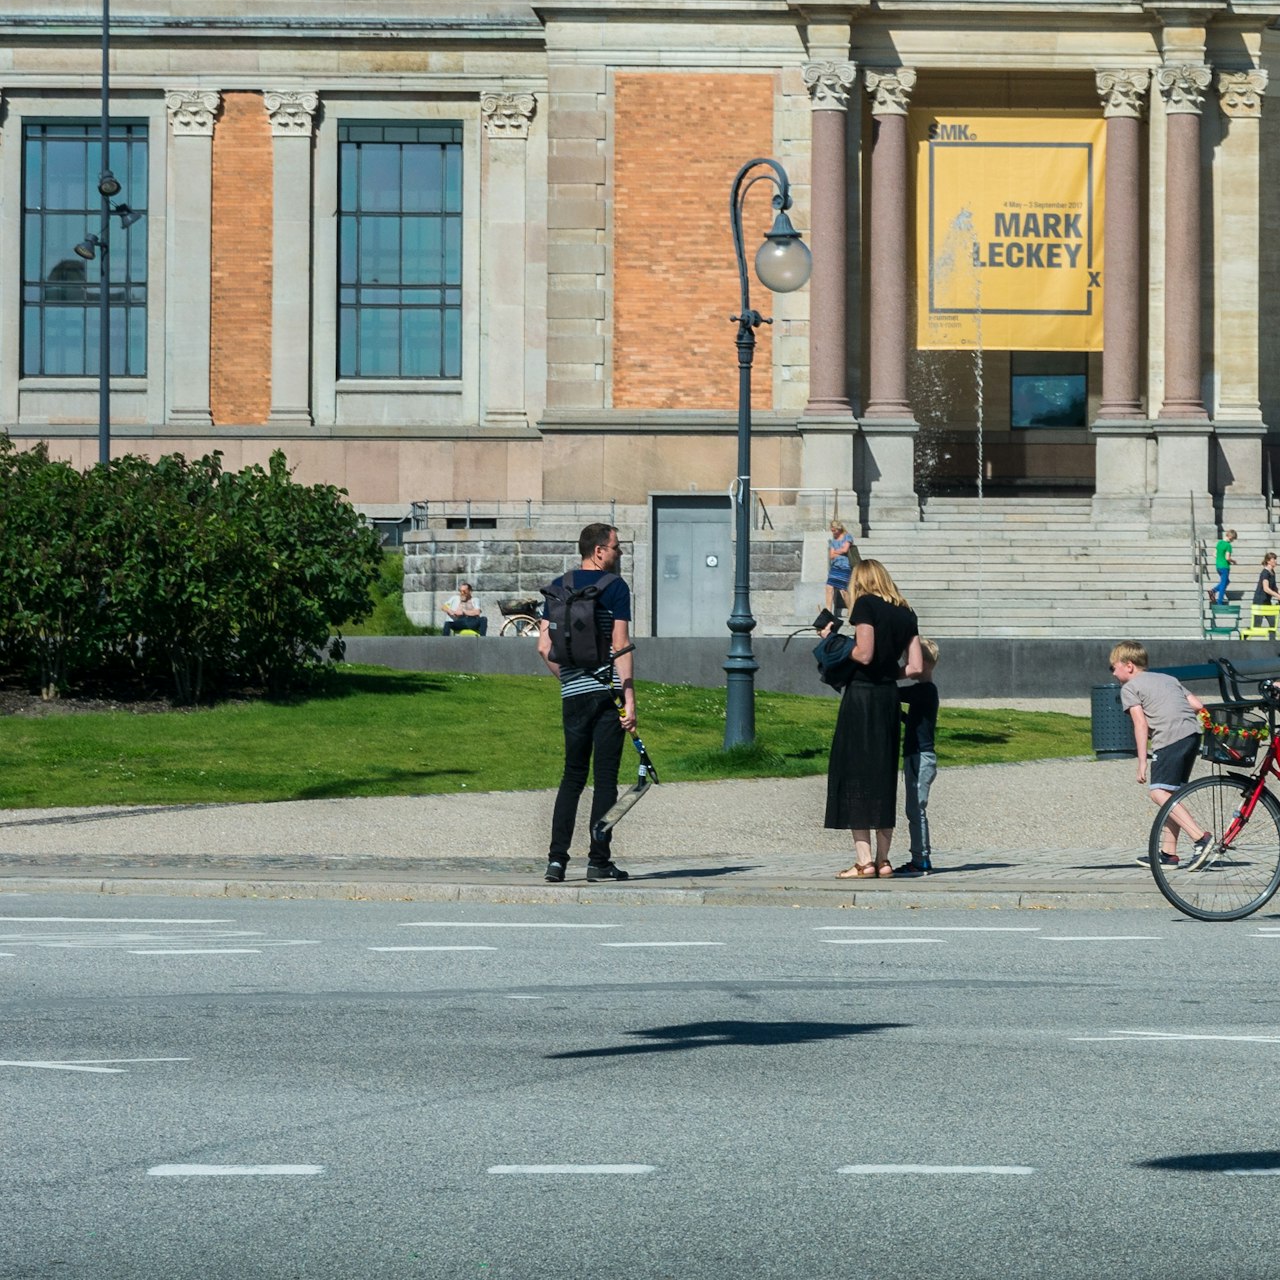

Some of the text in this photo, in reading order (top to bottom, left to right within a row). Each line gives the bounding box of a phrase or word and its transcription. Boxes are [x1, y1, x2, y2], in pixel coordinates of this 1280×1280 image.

[928, 123, 970, 141] SMK
[994, 212, 1083, 238] MARK
[973, 242, 1083, 269] LECKEY
